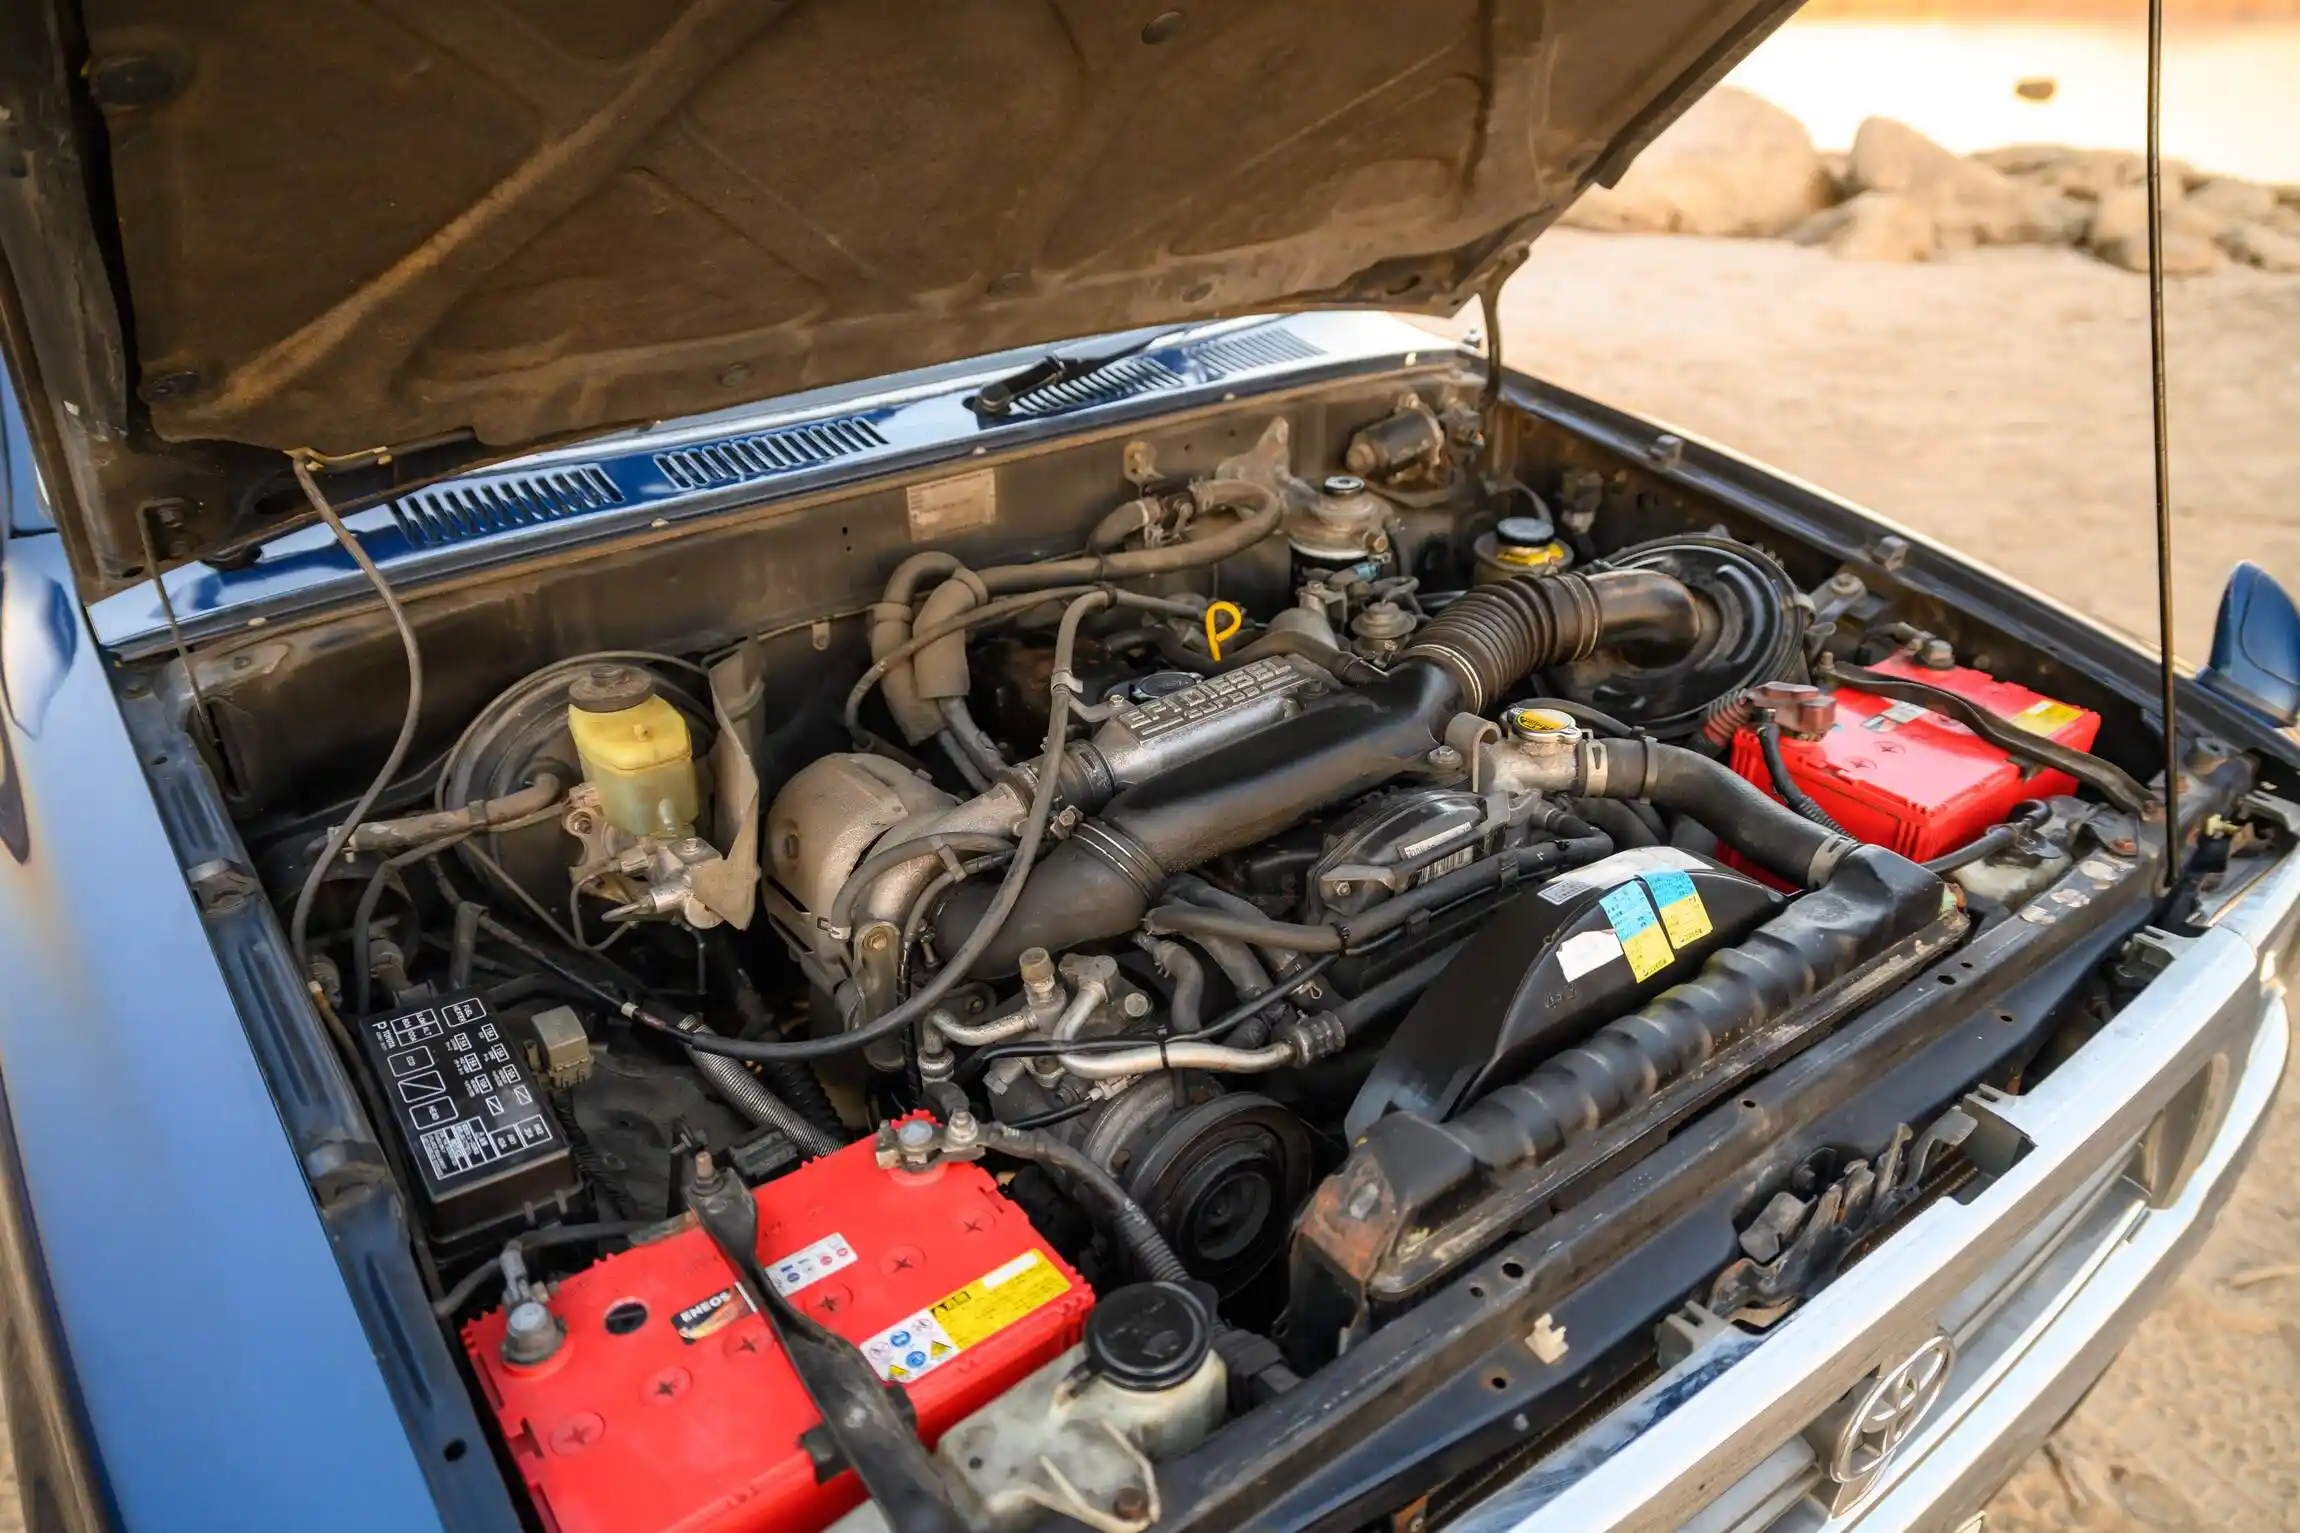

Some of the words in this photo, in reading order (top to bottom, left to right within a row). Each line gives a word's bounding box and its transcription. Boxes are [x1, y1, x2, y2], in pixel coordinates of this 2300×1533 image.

[1118, 699, 1182, 729] EFI
[1183, 661, 1292, 706] DIESEL
[453, 1005, 466, 1023] HEATER
[462, 1004, 473, 1018] FUEL
[372, 1021, 387, 1030] P
[383, 1029, 396, 1049] TOYOTA
[422, 1026, 432, 1036] ALT
[680, 1291, 731, 1322] ENEOS
